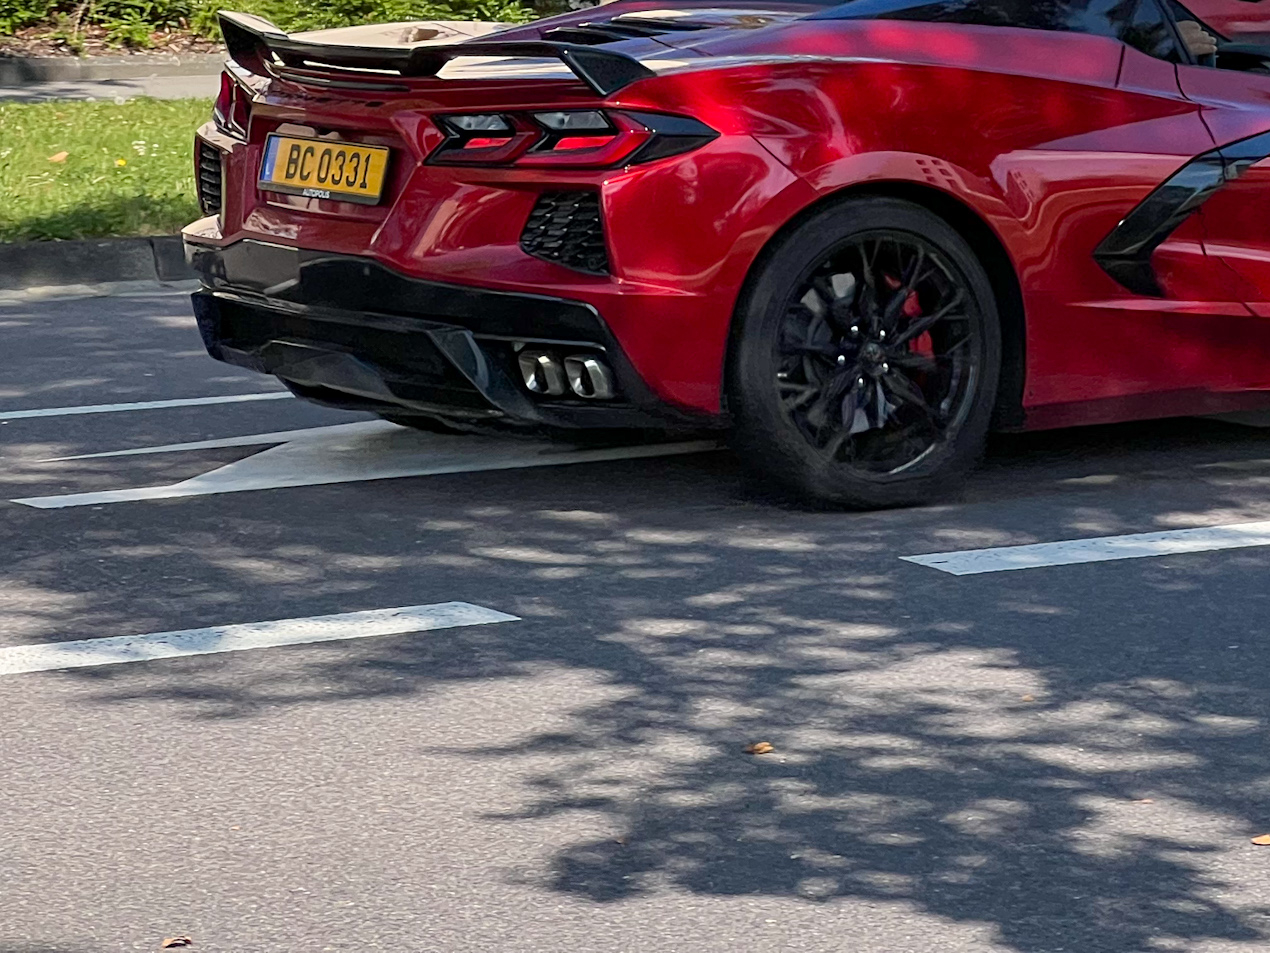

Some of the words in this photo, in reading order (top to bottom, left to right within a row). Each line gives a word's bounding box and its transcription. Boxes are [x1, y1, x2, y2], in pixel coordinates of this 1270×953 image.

[285, 144, 315, 181] BC
[317, 148, 371, 189] 0331
[302, 188, 330, 199] AUTOPOLIS
